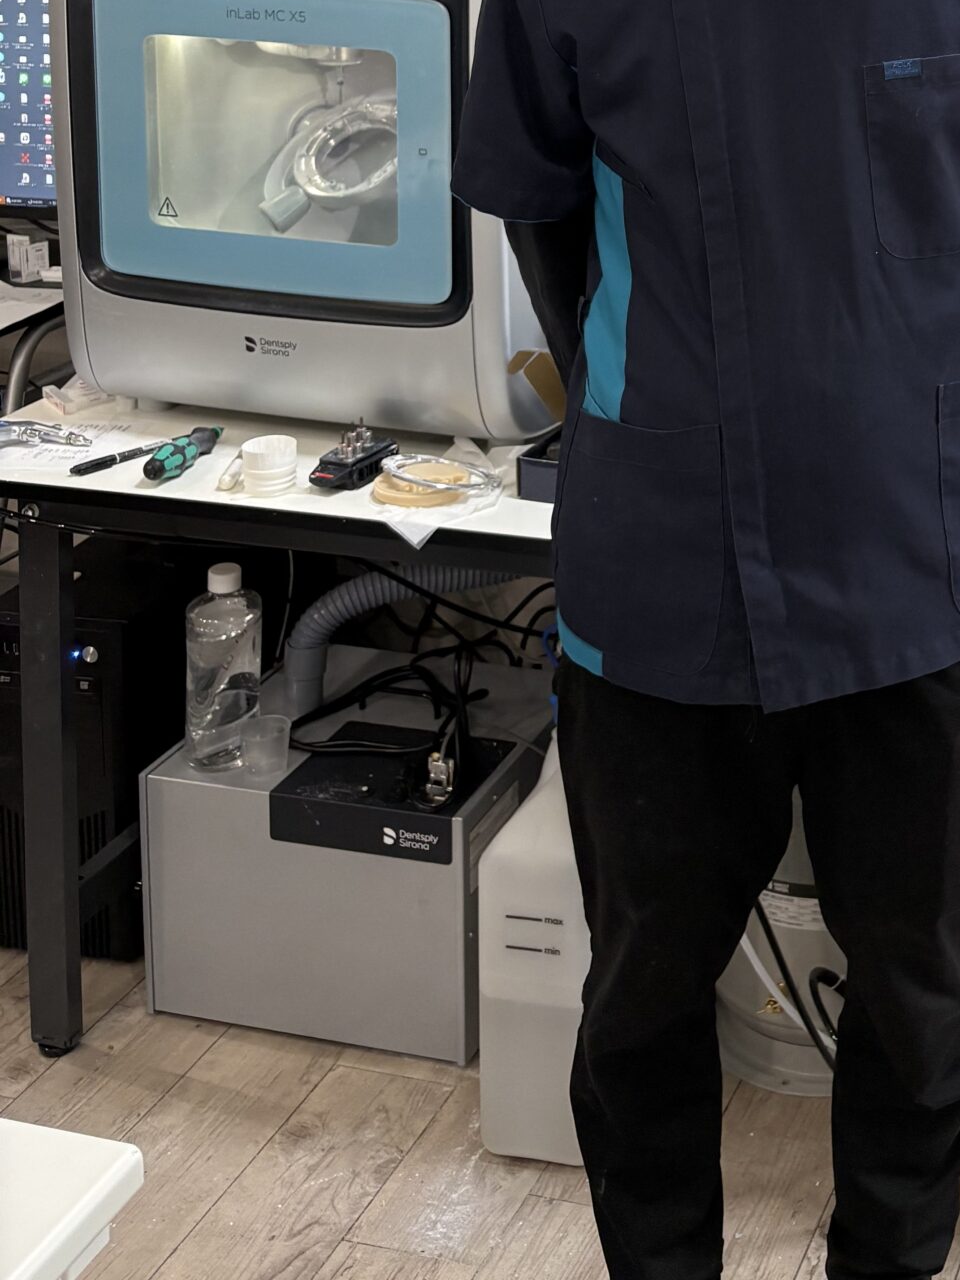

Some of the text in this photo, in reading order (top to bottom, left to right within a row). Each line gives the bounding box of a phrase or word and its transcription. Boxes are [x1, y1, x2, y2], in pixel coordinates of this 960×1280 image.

[226, 6, 307, 24] inLab MC X5
[260, 337, 297, 351] Dentsply
[260, 346, 290, 357] Sirona
[399, 829, 439, 845] Dentsply
[399, 839, 430, 851] Sirona
[544, 916, 564, 926] max
[544, 946, 561, 956] min
